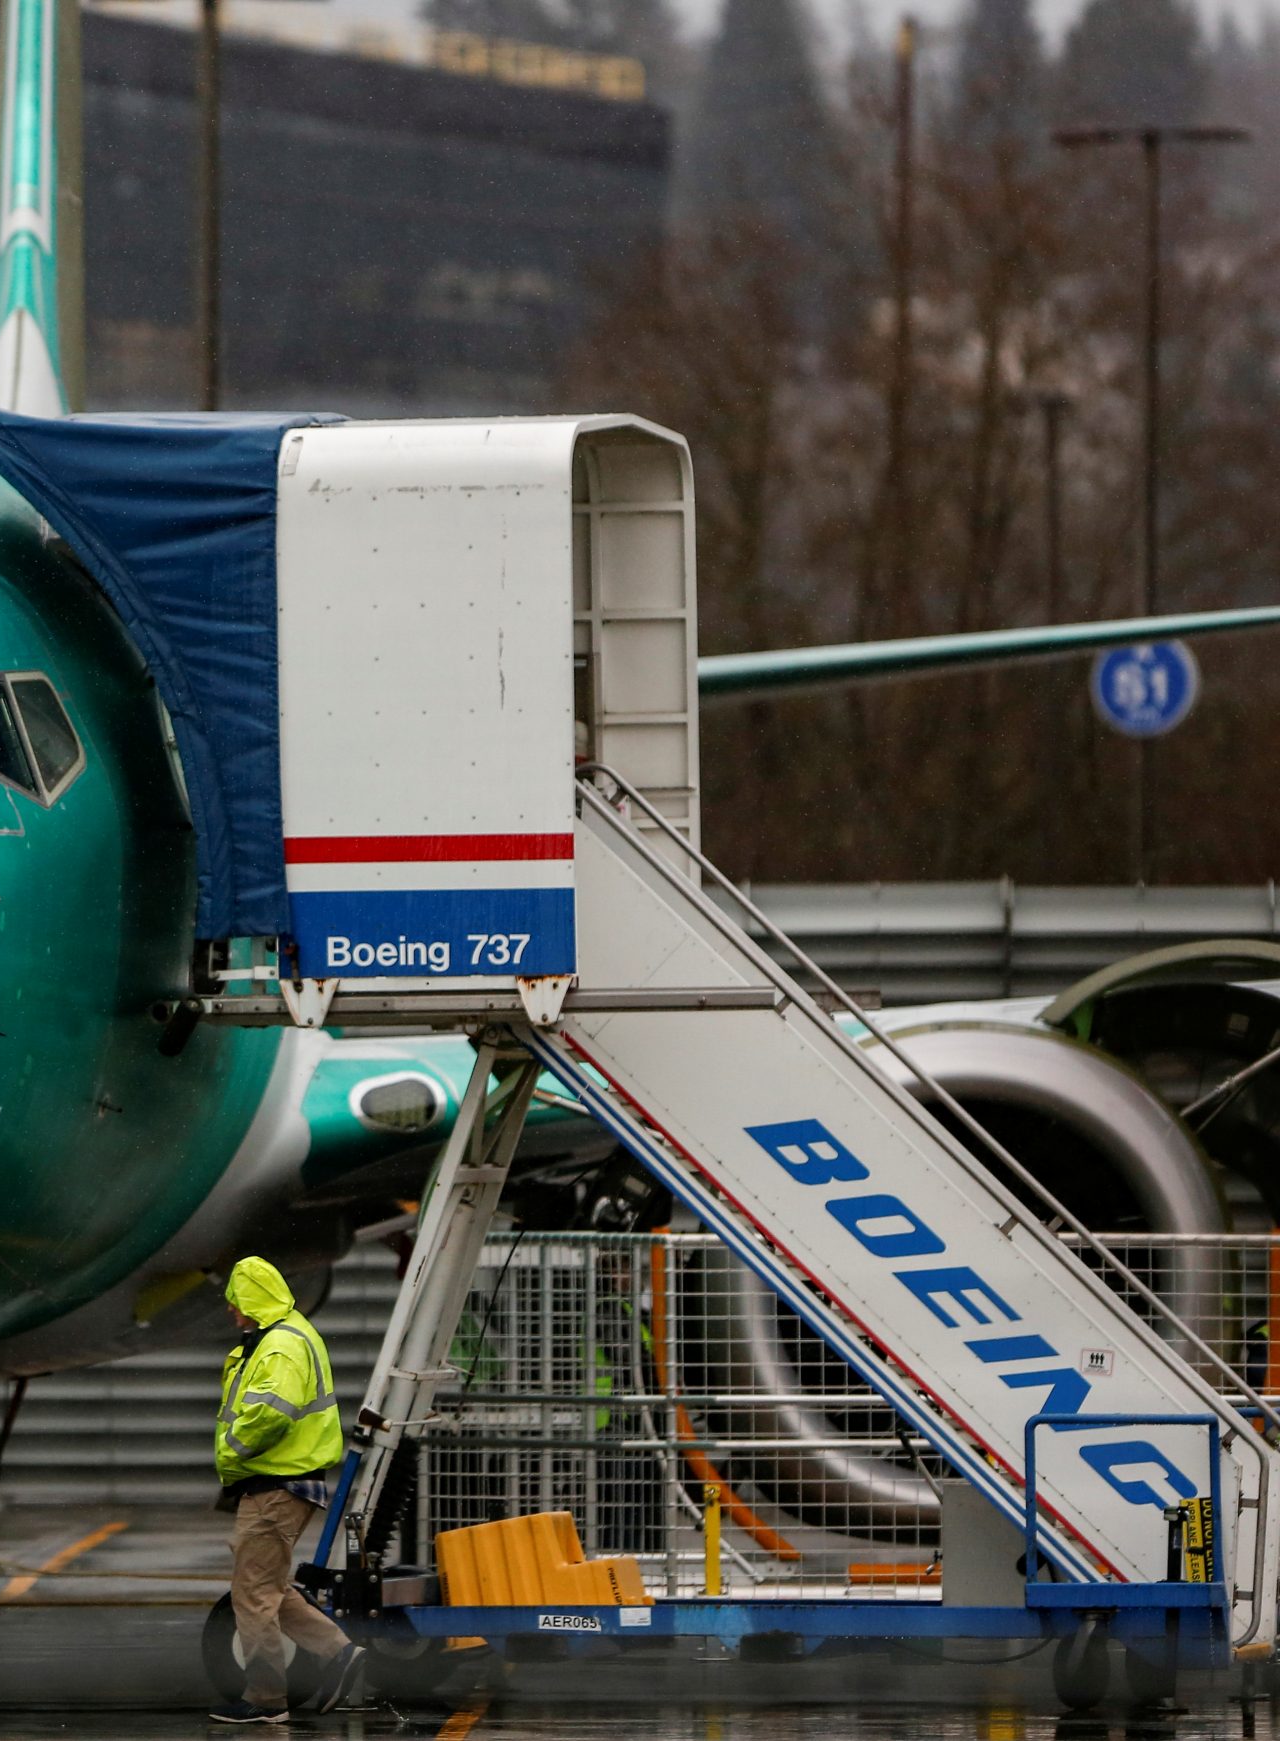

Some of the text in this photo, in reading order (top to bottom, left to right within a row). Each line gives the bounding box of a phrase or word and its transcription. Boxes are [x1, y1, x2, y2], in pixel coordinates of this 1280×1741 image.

[326, 934, 531, 972] Boeing 737
[743, 1118, 1199, 1511] BOEING
[541, 1615, 598, 1629] AER065
